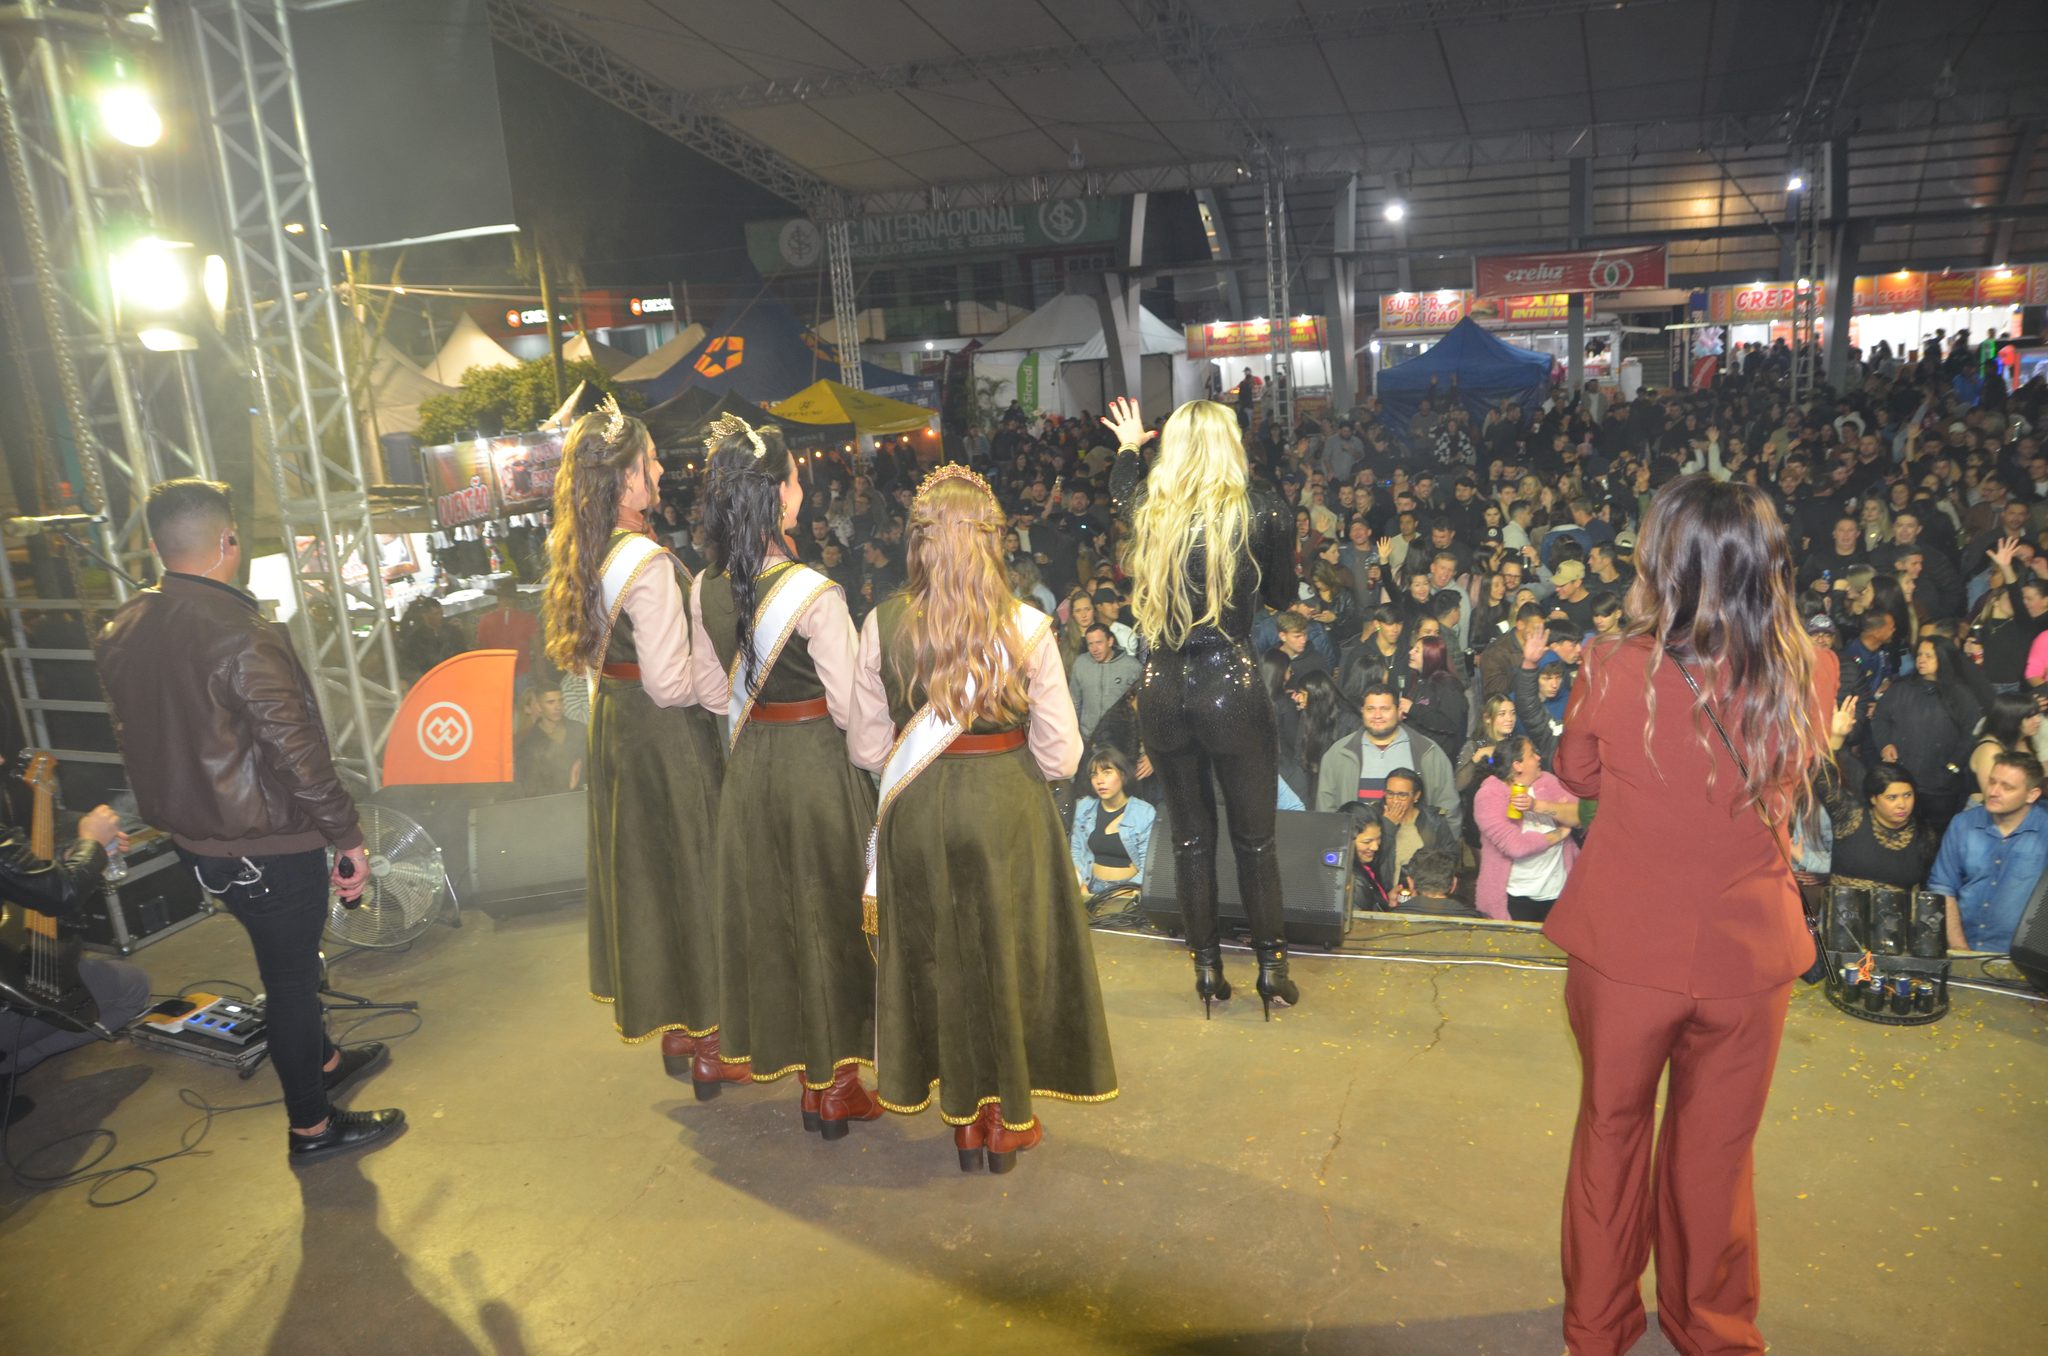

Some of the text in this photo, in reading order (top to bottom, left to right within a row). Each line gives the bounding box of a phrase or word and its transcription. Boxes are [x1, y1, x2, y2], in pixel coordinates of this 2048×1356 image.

[863, 206, 1025, 245] INTERNACIONAL
[1504, 262, 1565, 283] creluz
[1386, 297, 1439, 313] SUPER
